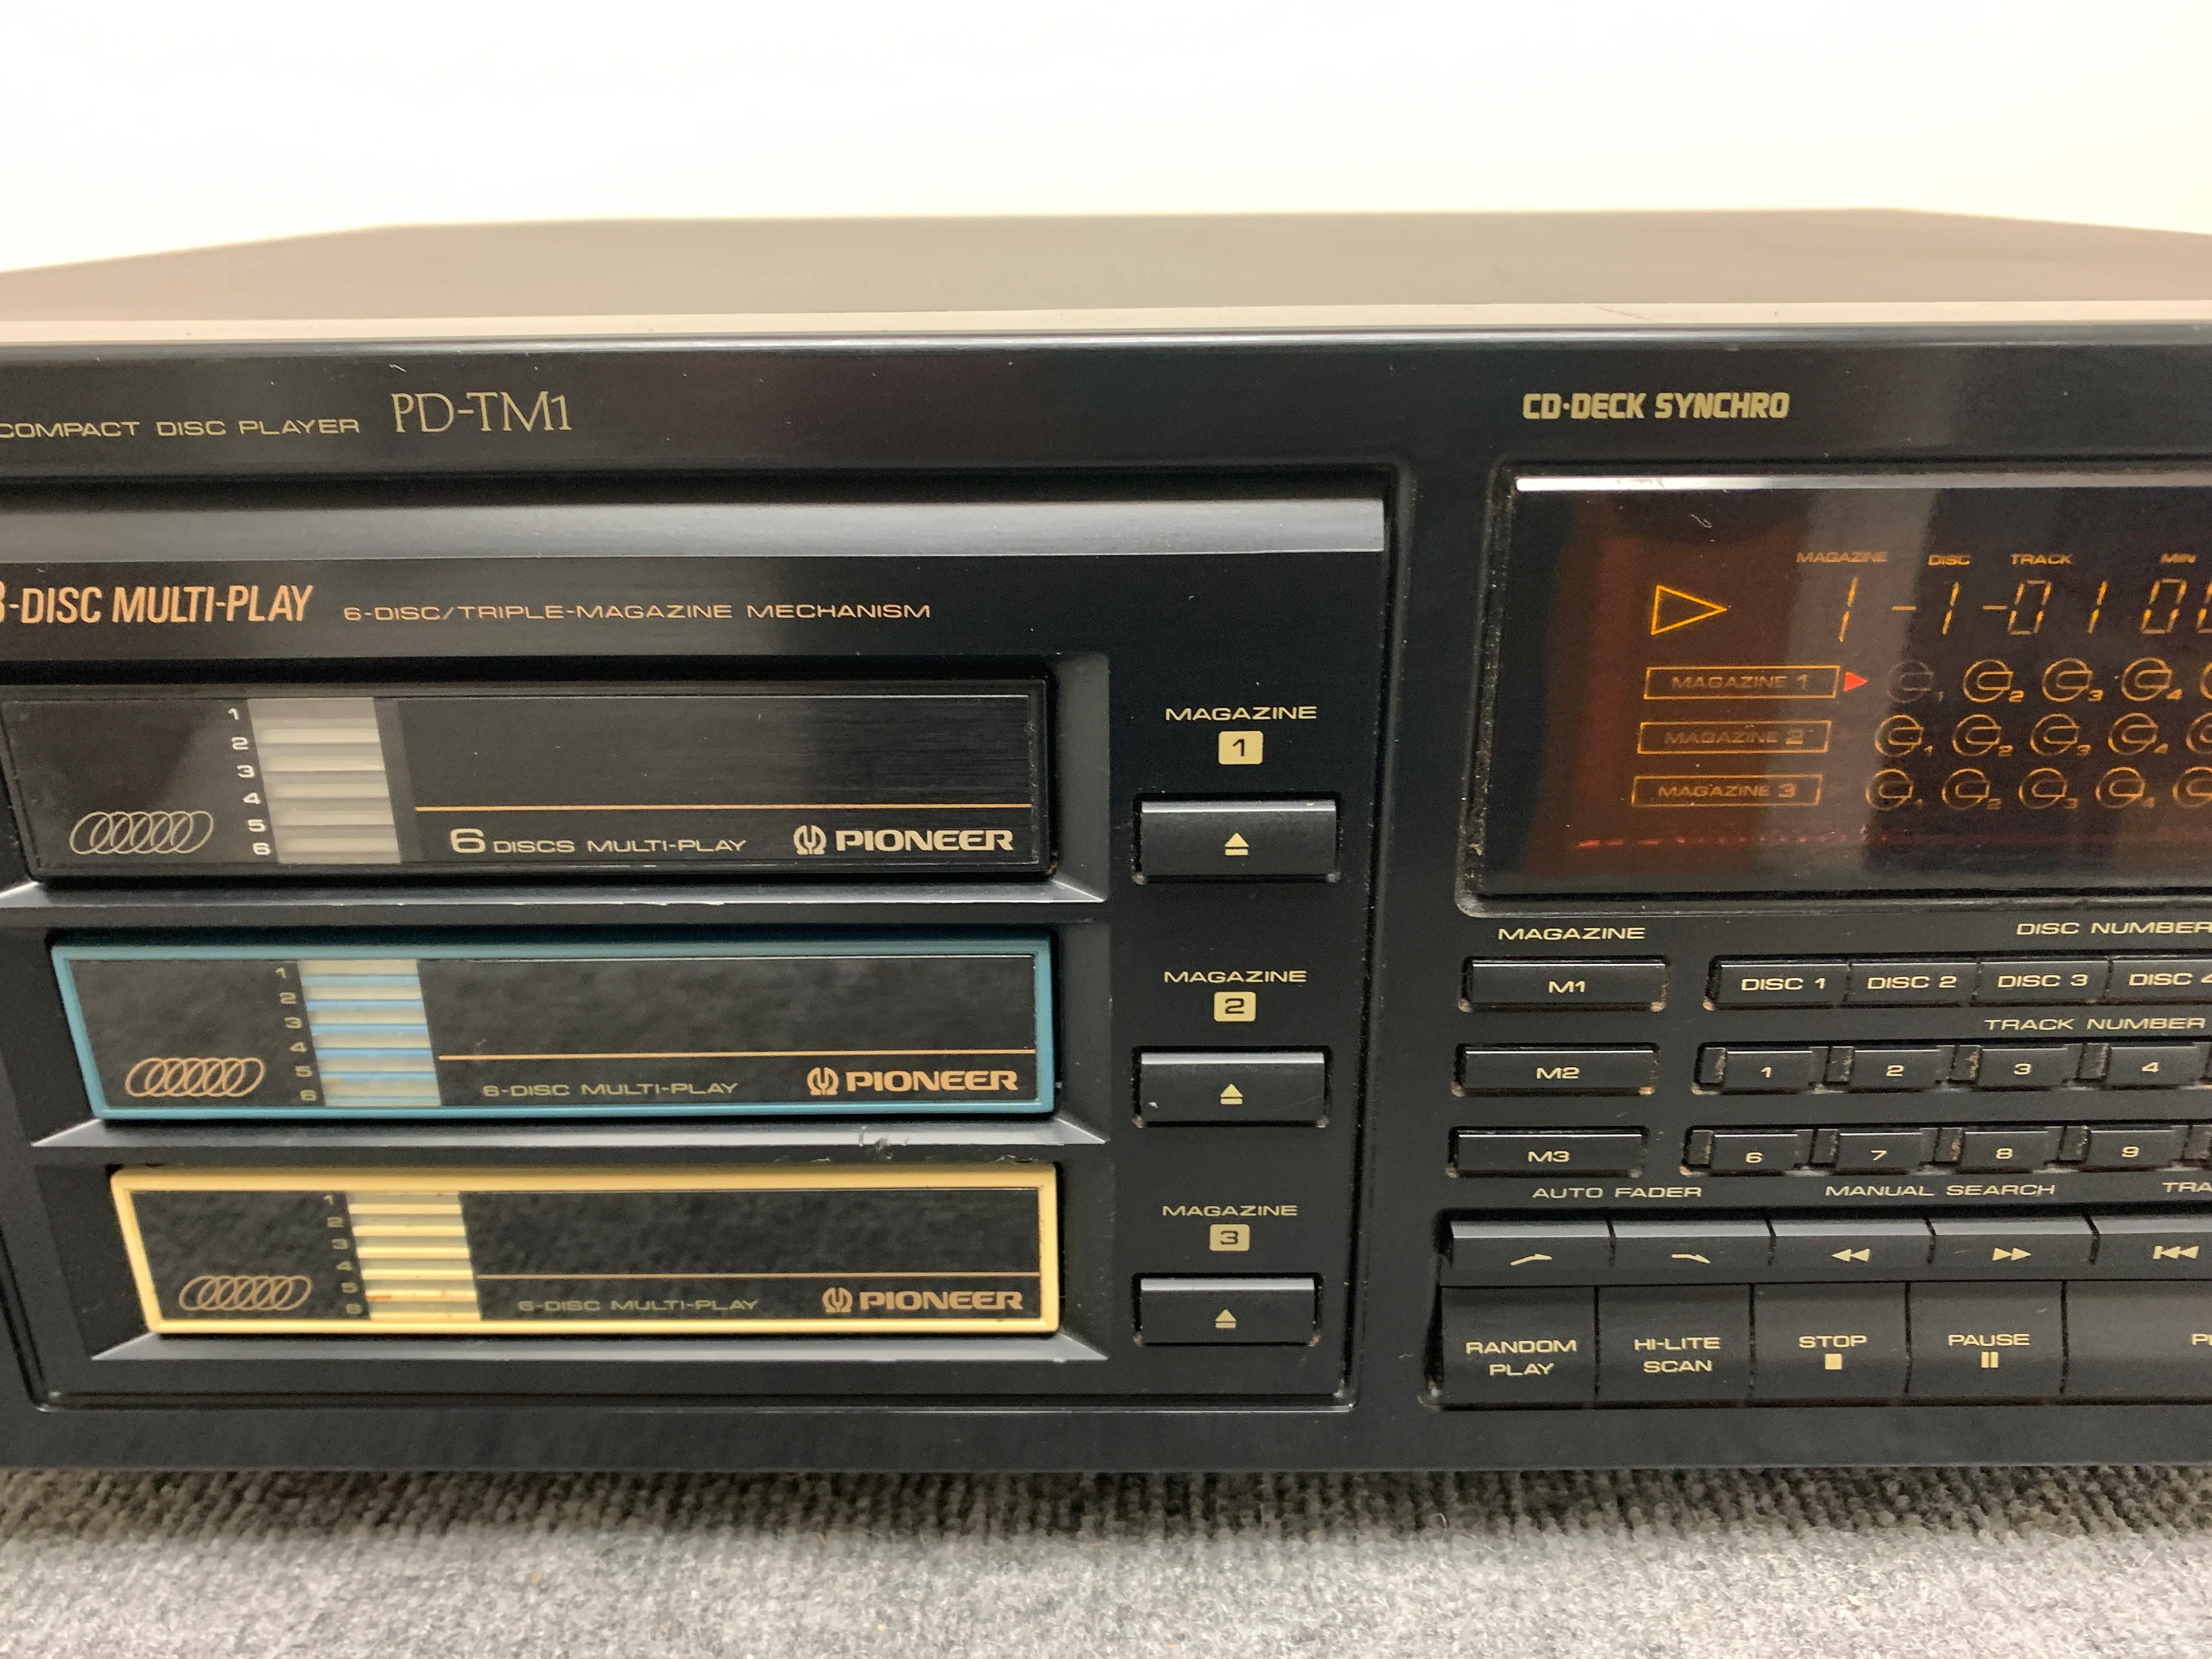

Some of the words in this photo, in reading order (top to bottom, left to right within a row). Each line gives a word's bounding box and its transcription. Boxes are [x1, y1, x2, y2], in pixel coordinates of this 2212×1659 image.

[391, 391, 572, 432] PD-TM1
[1655, 392, 1790, 419] SYNCHRO
[0, 421, 140, 438] COMPACT
[156, 420, 226, 436] DISC
[238, 419, 359, 435] PLAYER
[1797, 551, 1887, 563] MAGAZINE
[1928, 555, 1970, 566] DISC
[2011, 554, 2071, 565] TRACK
[112, 585, 313, 623] MULTI-PLAY
[747, 604, 930, 618] MECHANISM
[1672, 675, 1787, 689] MAGAZINE
[1797, 674, 1807, 689] 1
[228, 708, 239, 720] 1
[1166, 706, 1317, 721] MAGAZINE
[231, 737, 249, 750] 2
[1665, 731, 1778, 744] MAGAZINE
[1786, 730, 1804, 744] 2
[1233, 738, 1245, 757] 1
[236, 765, 255, 778] 3
[1658, 784, 1770, 797] MAGAZINE
[1779, 784, 1796, 798] 3
[243, 792, 261, 804] 4
[247, 819, 266, 832] 5
[450, 828, 486, 853] 6
[493, 840, 575, 853] DISCS
[587, 839, 746, 853] MULTI-PLAY
[836, 829, 1013, 851] PIONEER
[252, 842, 271, 855] 6
[1498, 927, 1645, 940] MAGAZINE
[2016, 922, 2080, 935] DISC
[2091, 921, 2212, 934] NUMBER
[275, 967, 286, 978] 1
[1164, 970, 1307, 984] MAGAZINE
[1741, 978, 1804, 991] DISC
[1815, 978, 1825, 989] 1
[1867, 976, 1930, 989] DISC
[1939, 975, 1957, 988] 2
[1997, 974, 2061, 988] DISC
[2070, 974, 2088, 986] 3
[2129, 973, 2193, 986] DISC
[1549, 980, 1585, 993] M1
[279, 992, 296, 1005] 2
[1225, 998, 1245, 1014] 2
[284, 1017, 302, 1029] 3
[1984, 1018, 2074, 1030] TRACK
[2087, 1017, 2206, 1030] NUMBER
[290, 1041, 307, 1053] 4
[295, 1065, 313, 1077] 5
[1537, 1066, 1580, 1079] M2
[1761, 1066, 1771, 1078] 1
[1886, 1065, 1904, 1076] 2
[2013, 1063, 2032, 1075] 3
[2142, 1062, 2159, 1073] 4
[845, 1070, 1018, 1092] PIONEER
[300, 1090, 317, 1101] 6
[482, 1084, 570, 1097] 6-DISC
[581, 1082, 738, 1096] MULTI-PLAY
[1528, 1150, 1570, 1163] M3
[1746, 1152, 1763, 1163] 6
[1871, 1150, 1887, 1161] 7
[1996, 1148, 2013, 1159] 8
[2121, 1146, 2140, 1158] 9
[1532, 1187, 1603, 1199] AUTO
[1615, 1187, 1702, 1198] FADER
[1825, 1186, 1934, 1197] MANUAL
[1946, 1184, 2056, 1196] SEARCH
[1163, 1205, 1297, 1217] MAGAZINE
[1220, 1230, 1239, 1245] 3
[610, 1300, 758, 1311] MULTI-PLAY
[859, 1291, 1023, 1311] PIONEER
[1634, 1336, 1720, 1351] HI-LITE
[1799, 1335, 1867, 1348] STOP
[1948, 1333, 2030, 1346] PAUSE
[1466, 1339, 1577, 1354] RANDOM
[1489, 1363, 1554, 1376] PLAY
[1643, 1360, 1712, 1373] SCAN
